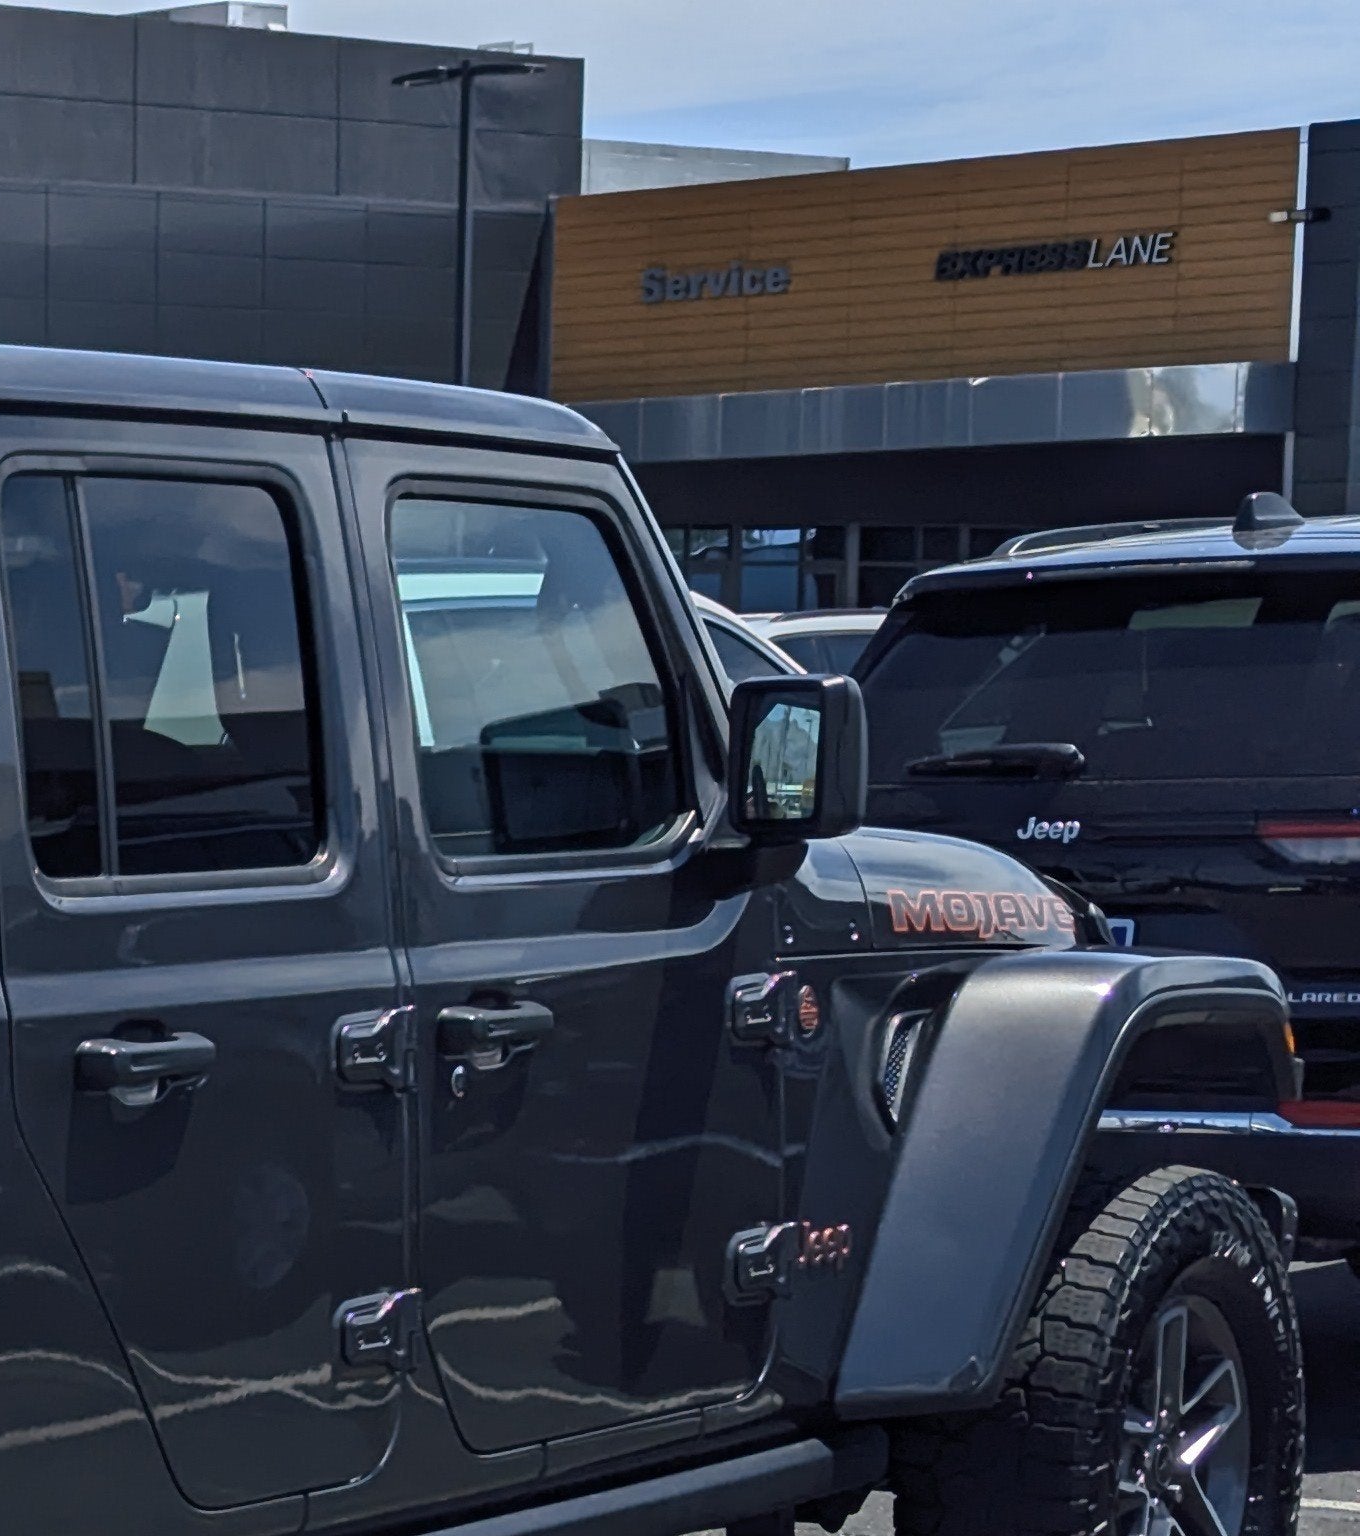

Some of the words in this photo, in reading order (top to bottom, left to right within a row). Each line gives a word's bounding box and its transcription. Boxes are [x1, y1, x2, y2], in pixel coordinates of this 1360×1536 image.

[642, 260, 791, 304] Service
[1017, 816, 1080, 843] Jeep
[887, 889, 1075, 939] MOJAVE
